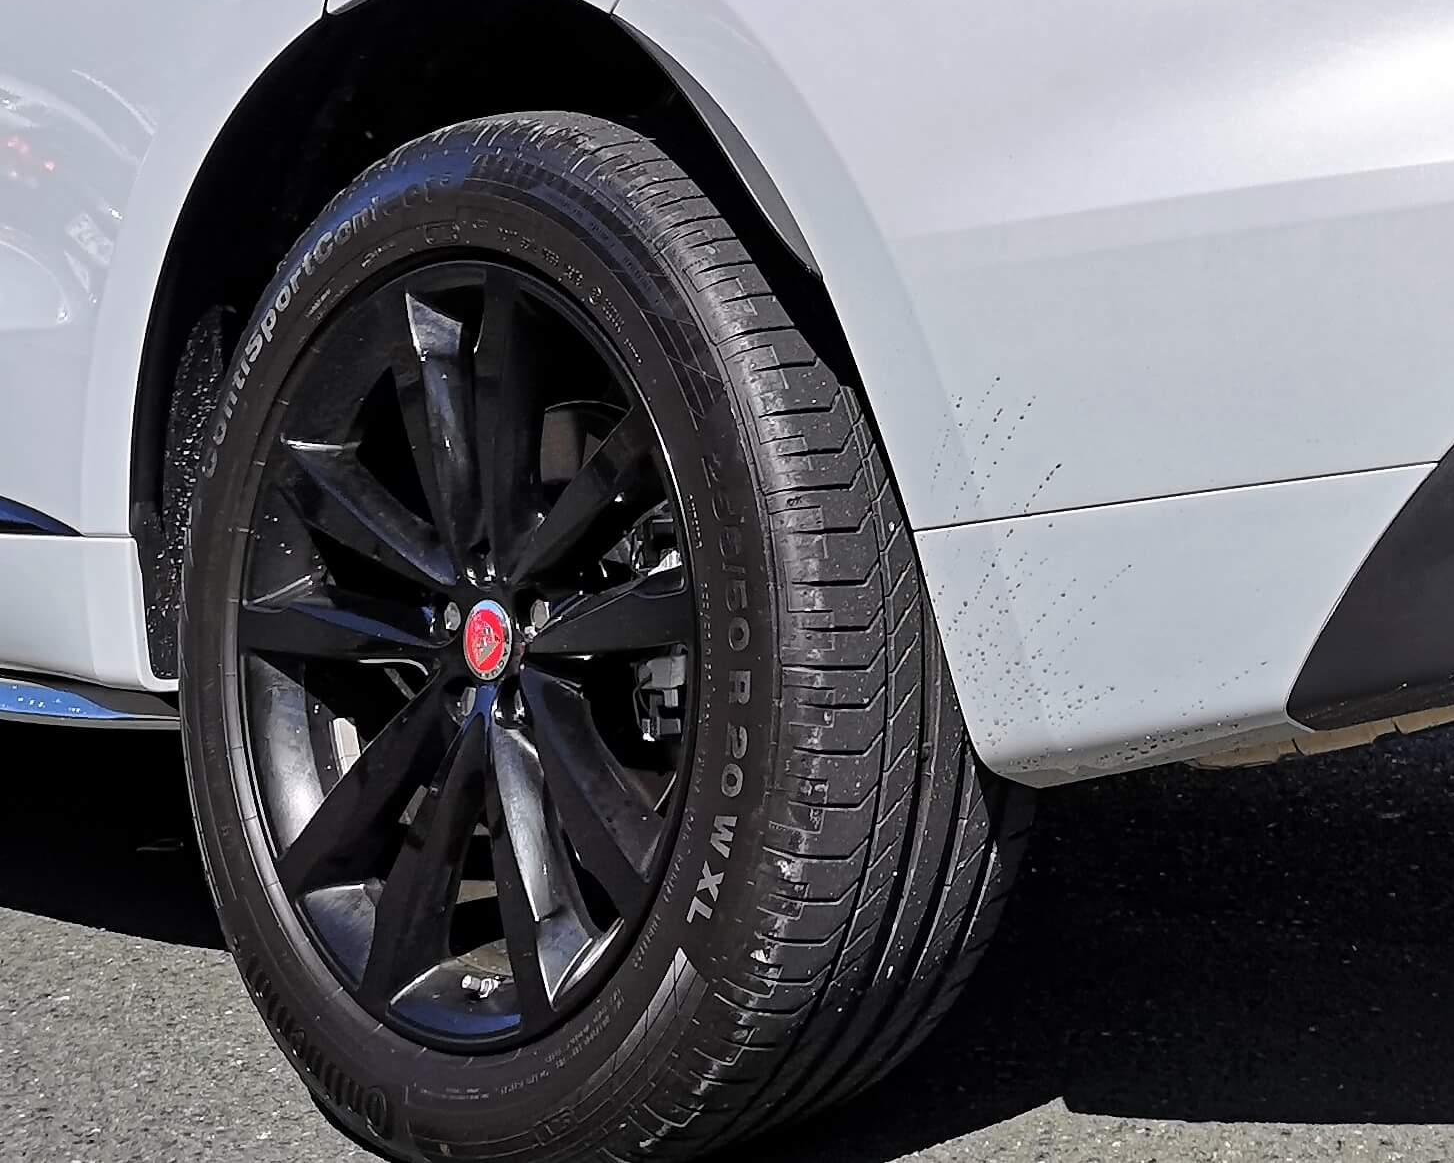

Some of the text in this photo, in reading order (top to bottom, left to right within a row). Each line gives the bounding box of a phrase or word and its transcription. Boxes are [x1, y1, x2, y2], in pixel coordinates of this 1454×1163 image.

[719, 723, 750, 801] 20
[708, 813, 739, 860] W
[685, 859, 725, 925] XL
